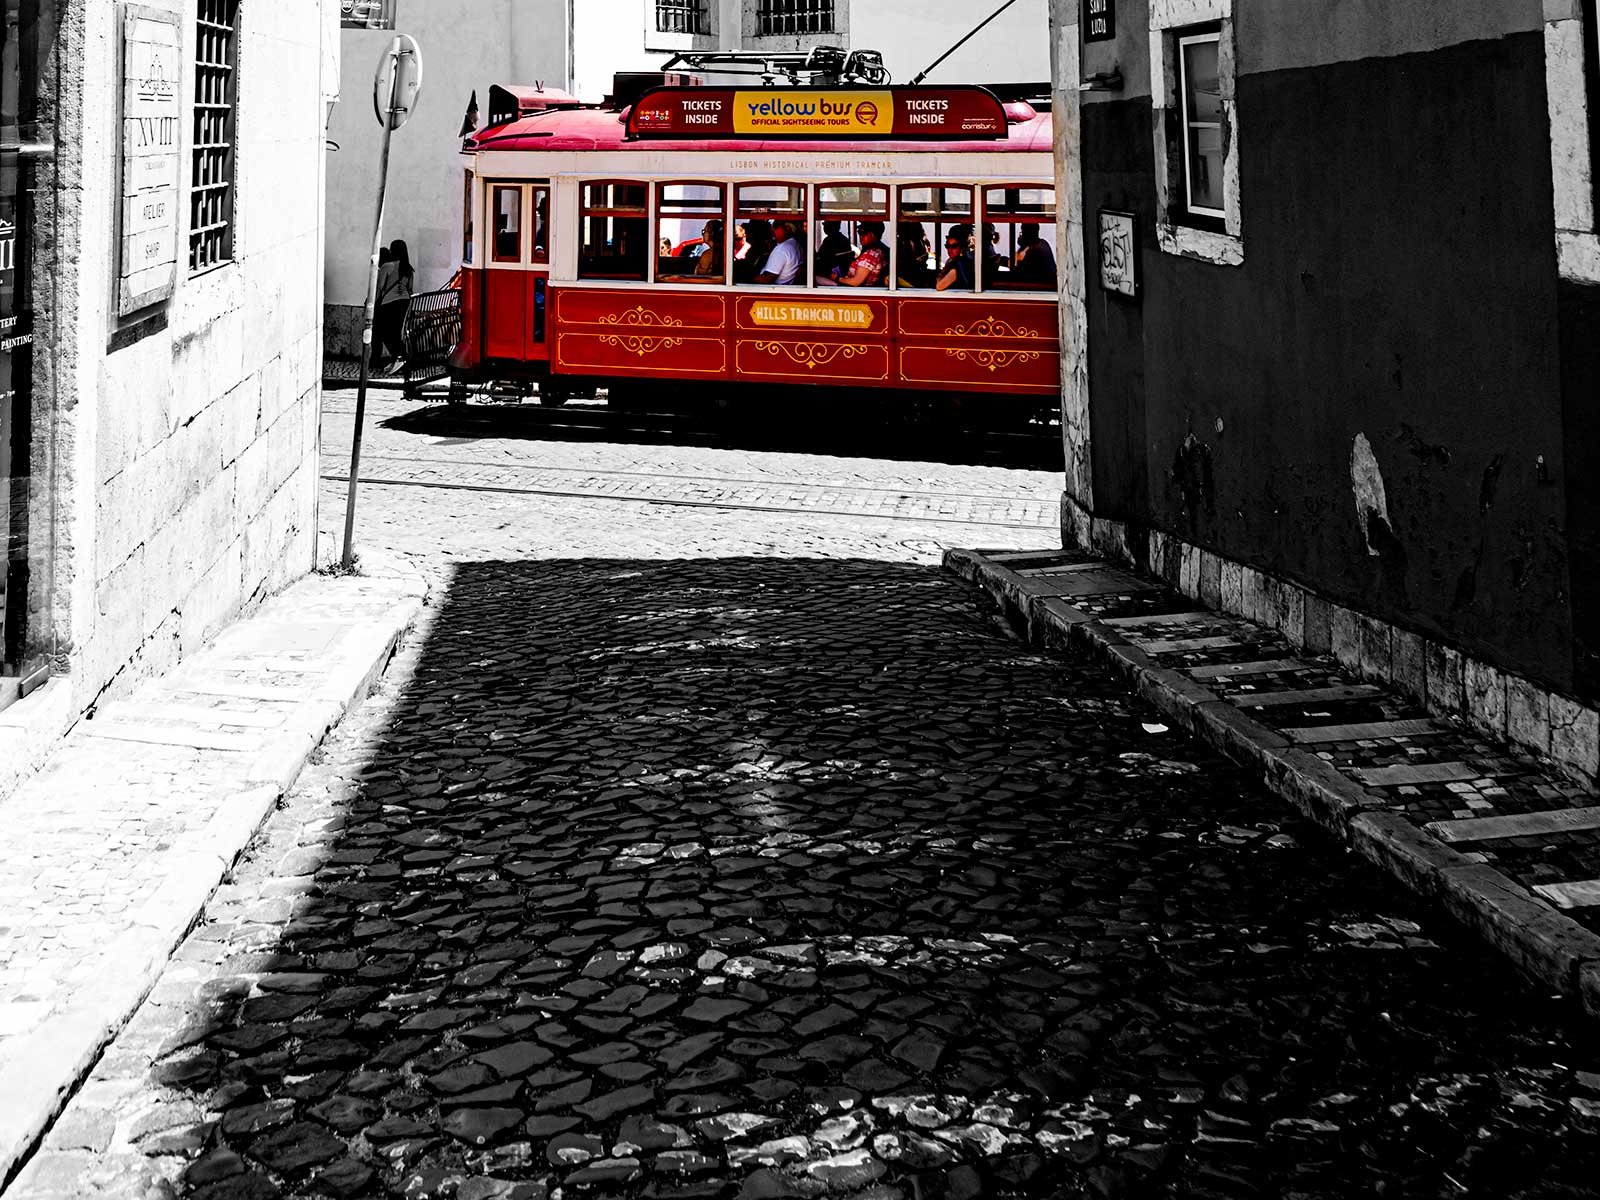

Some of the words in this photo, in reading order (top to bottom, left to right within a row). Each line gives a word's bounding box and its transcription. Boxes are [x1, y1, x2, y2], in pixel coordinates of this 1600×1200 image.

[1091, 18, 1106, 35] LUZIA
[682, 100, 722, 111] TICKETS
[748, 98, 816, 116] yellow
[820, 98, 853, 116] bus
[906, 99, 949, 110] TICKETS
[685, 114, 718, 124] INSIDE
[751, 118, 780, 126] OFFICIAL
[782, 118, 826, 126] SIGHTSEEING
[828, 118, 850, 126] TOURS
[909, 114, 945, 124] INSIDE
[137, 117, 173, 147] XVIII
[730, 160, 758, 169] LISBON
[763, 160, 809, 169] HISTORICAL
[815, 160, 850, 169] PREMIUM
[856, 161, 892, 170] TRAMCAR
[756, 306, 787, 320] HILLS
[790, 307, 835, 322] TRAMCAR
[837, 308, 865, 323] TOUR
[0, 333, 33, 351] PAINTING
